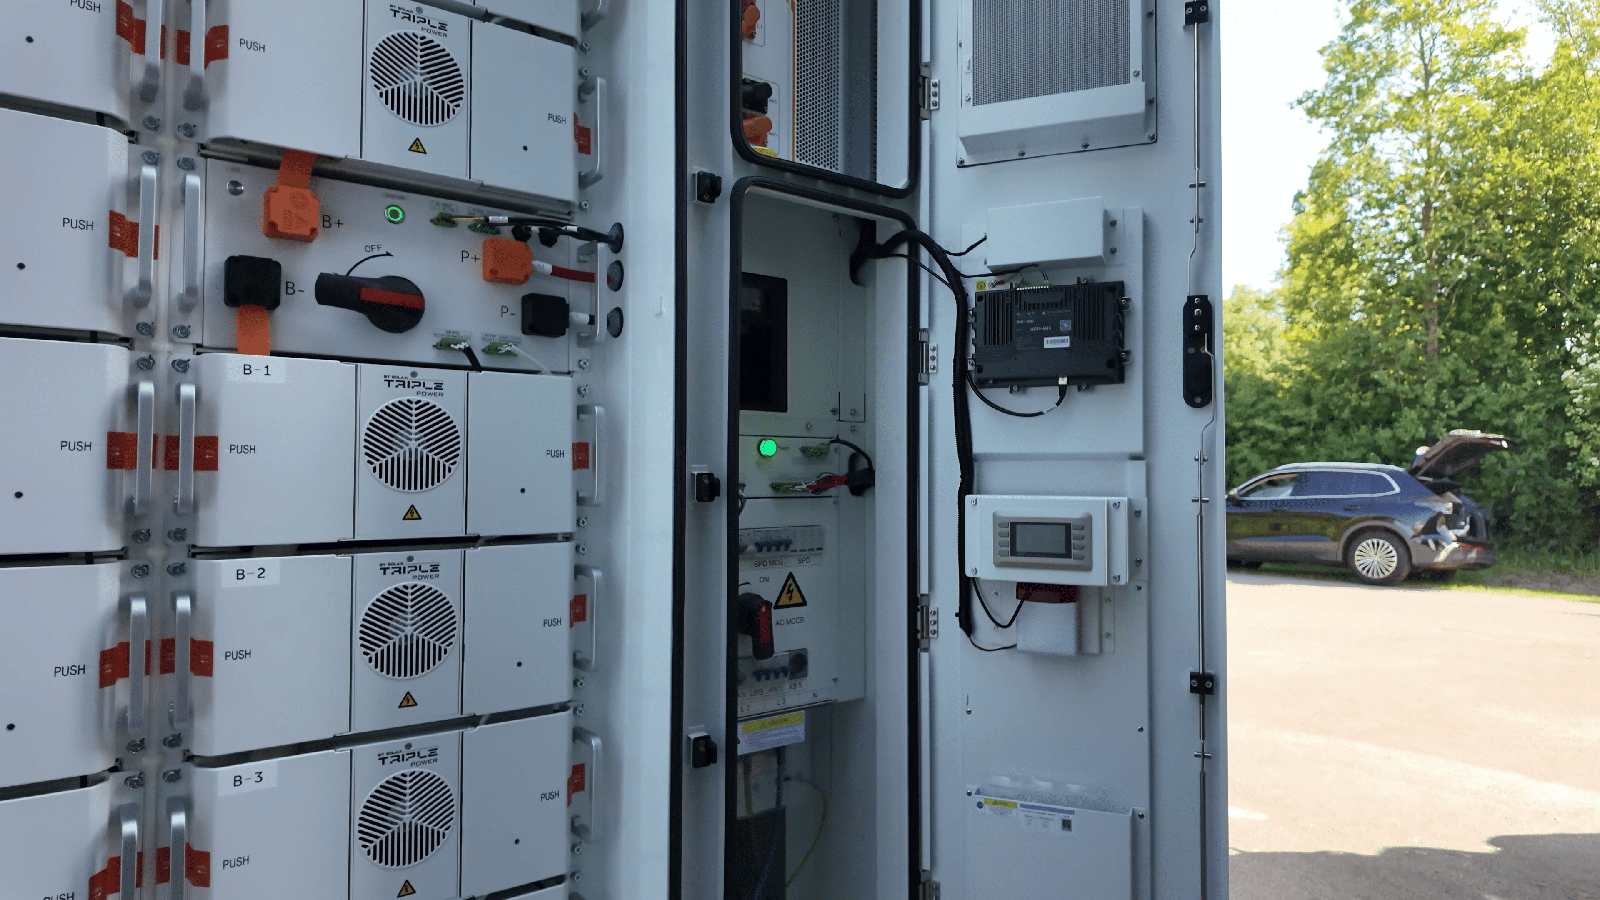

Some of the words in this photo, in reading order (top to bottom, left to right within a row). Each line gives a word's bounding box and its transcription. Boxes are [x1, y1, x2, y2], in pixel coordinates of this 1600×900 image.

[390, 8, 448, 32] TRIPLE
[421, 27, 448, 38] POWER
[240, 38, 266, 53] PUSH
[548, 113, 566, 124] PUSH
[63, 218, 94, 231] PUSH
[322, 215, 343, 228] B+
[364, 244, 382, 252] OFF
[462, 250, 480, 262] P+
[286, 281, 304, 295] B-
[501, 306, 516, 318] P-
[384, 379, 444, 390] TRIPLE
[60, 438, 92, 452] PUSH
[230, 444, 256, 455] PUSH
[546, 450, 564, 458] PUSH
[380, 564, 440, 576] TRIPLE
[543, 618, 562, 628] PUSH
[786, 616, 805, 626] MCCB
[224, 648, 252, 661] PUSH
[54, 664, 86, 678] PUSH
[378, 748, 438, 766] TRIPLE
[411, 758, 438, 768] POWER
[540, 790, 560, 802] PUSH
[222, 854, 250, 870] PUSH
